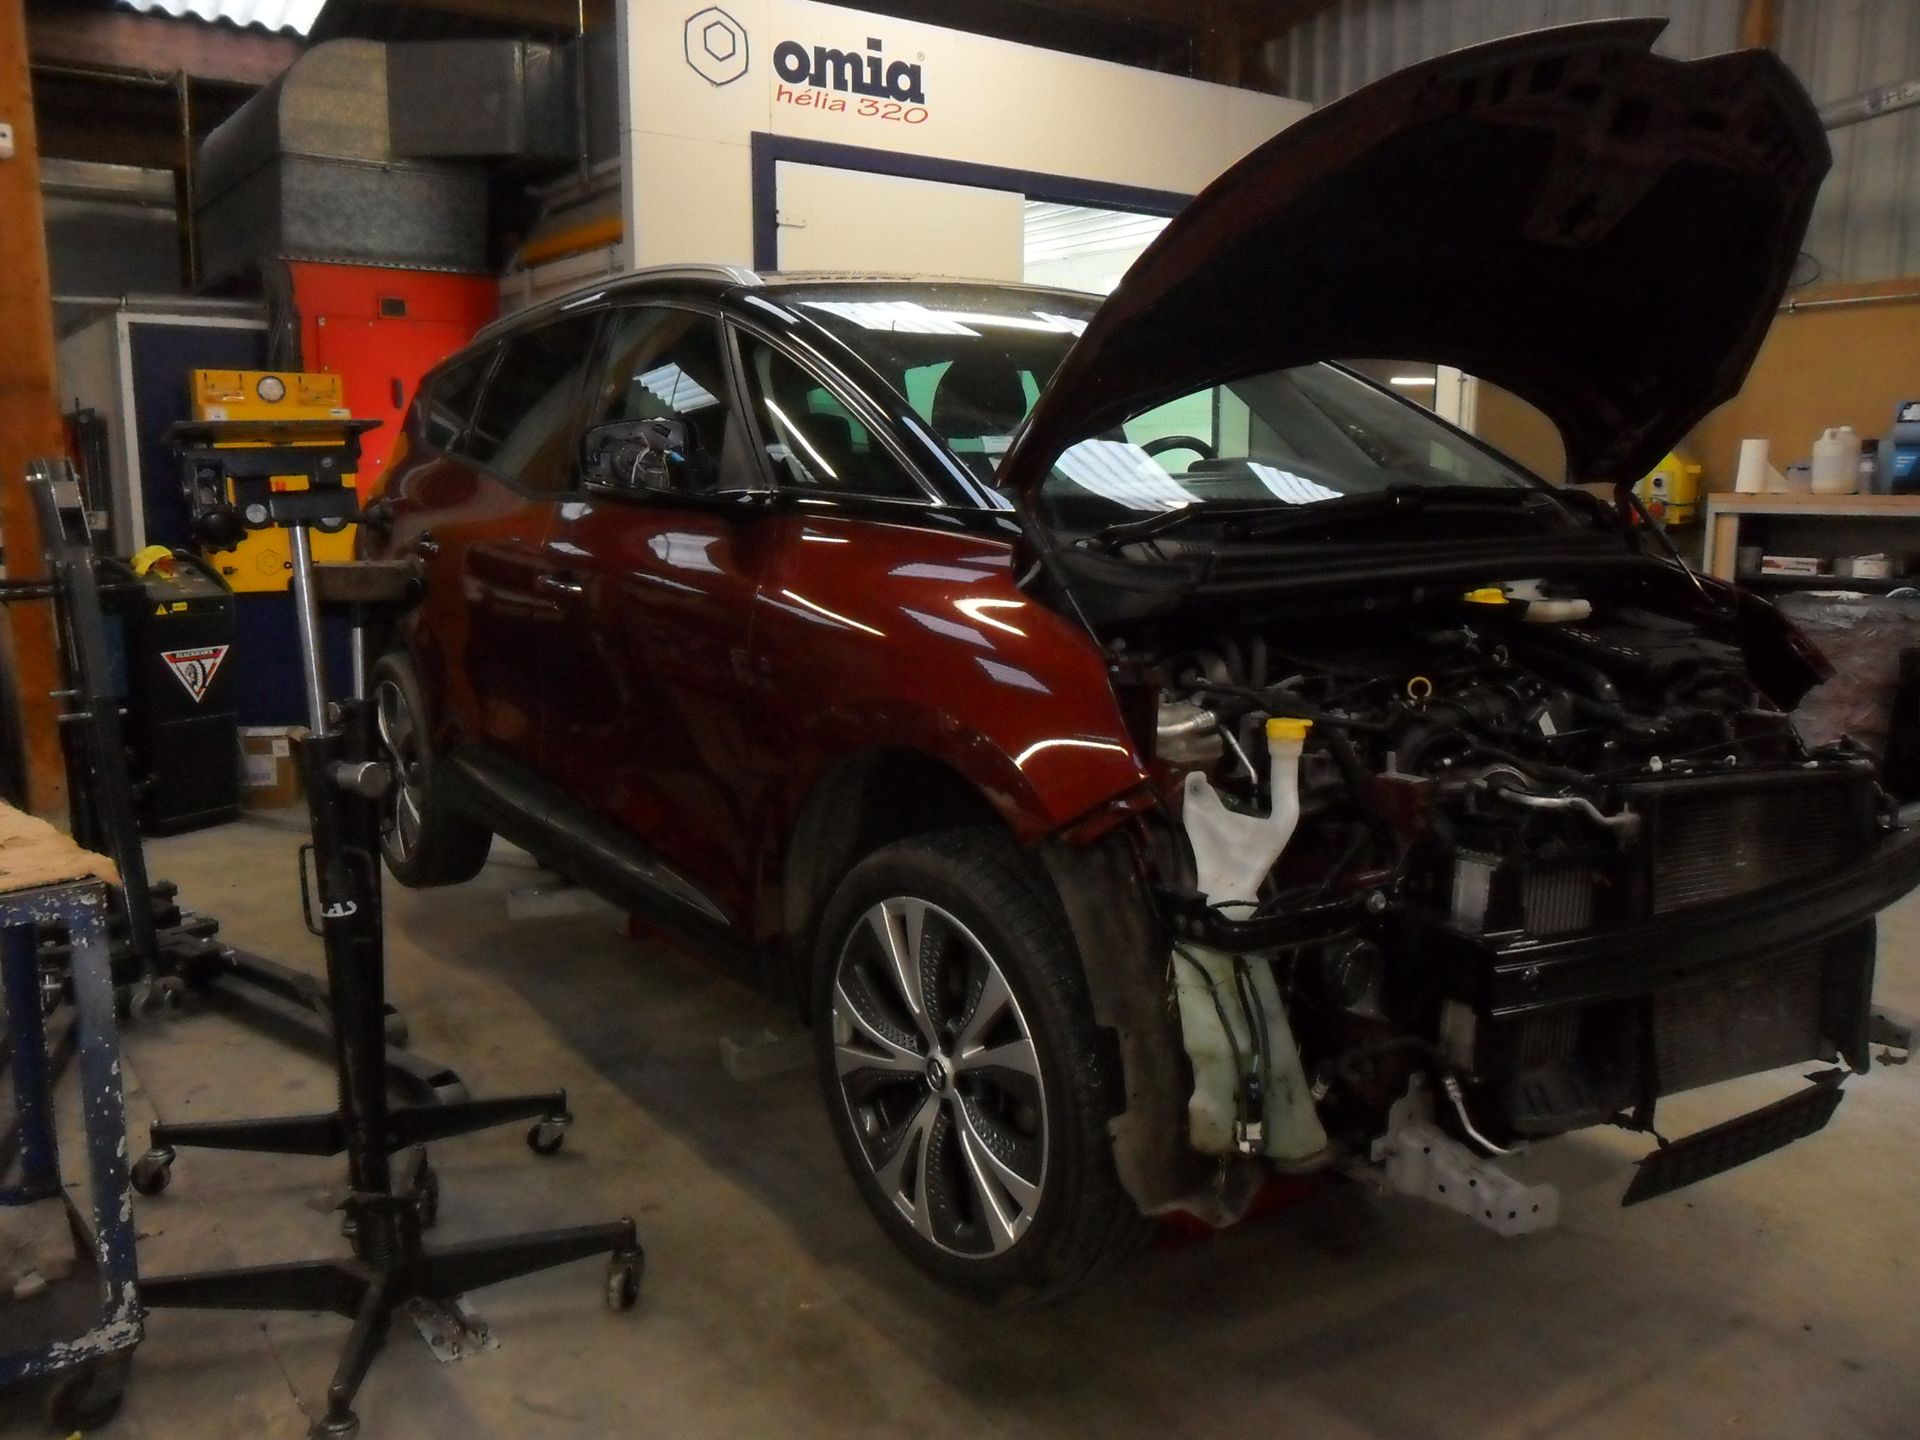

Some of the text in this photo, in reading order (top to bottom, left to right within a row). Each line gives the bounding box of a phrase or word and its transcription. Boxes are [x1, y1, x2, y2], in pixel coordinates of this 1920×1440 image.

[773, 37, 925, 104] omia
[776, 84, 929, 124] hélia 320
